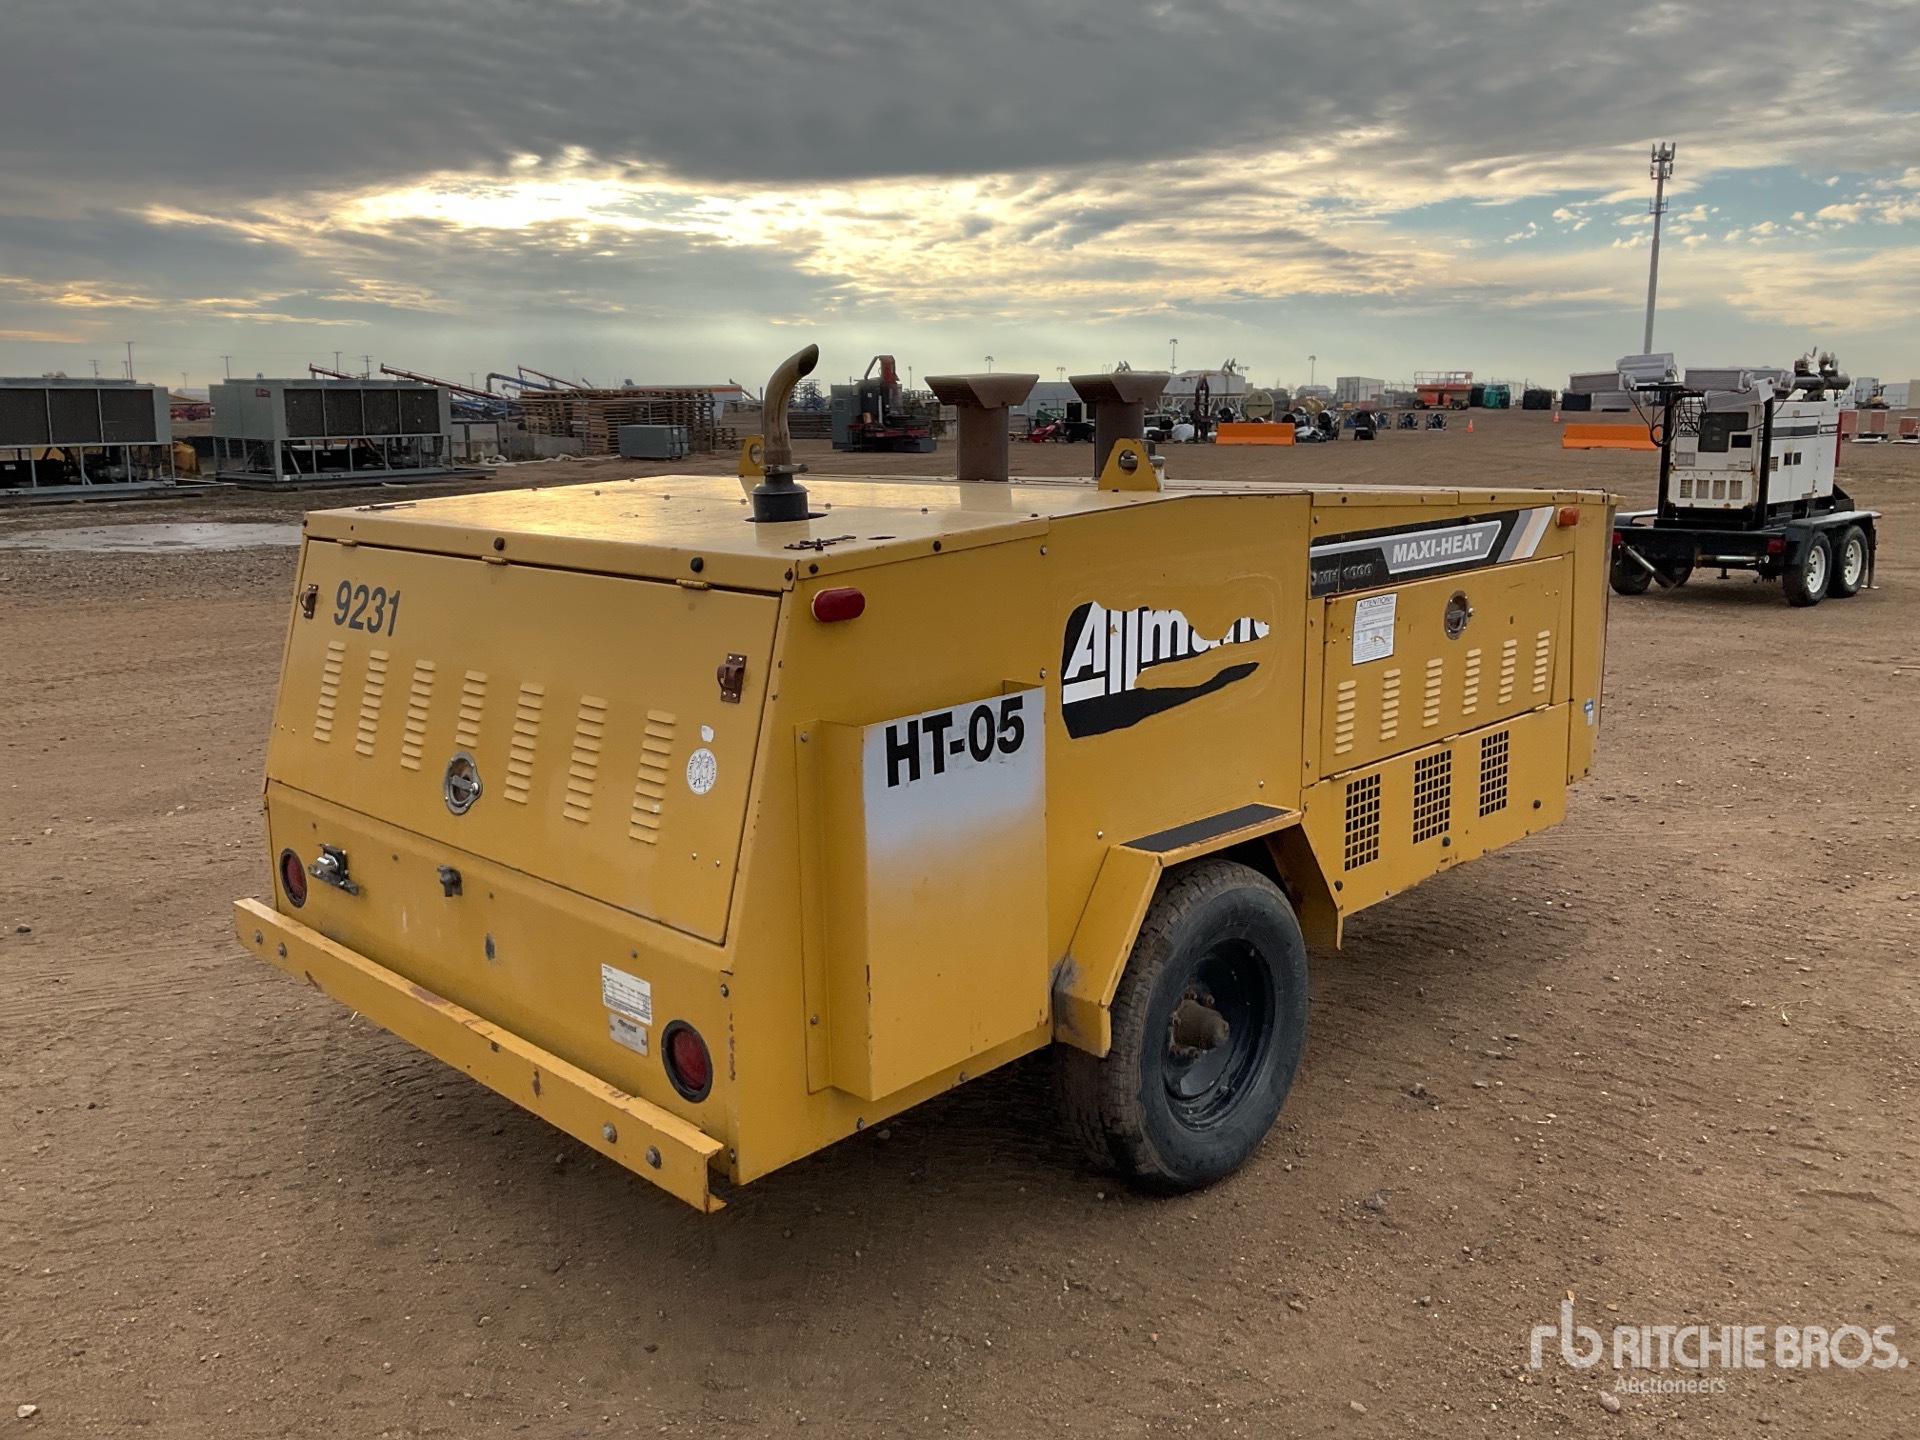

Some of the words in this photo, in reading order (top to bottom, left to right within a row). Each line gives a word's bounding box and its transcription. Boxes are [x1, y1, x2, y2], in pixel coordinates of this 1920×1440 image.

[1393, 532, 1483, 564] MAXI-HEAT
[334, 580, 400, 637] 9231
[886, 695, 1025, 788] HT-05
